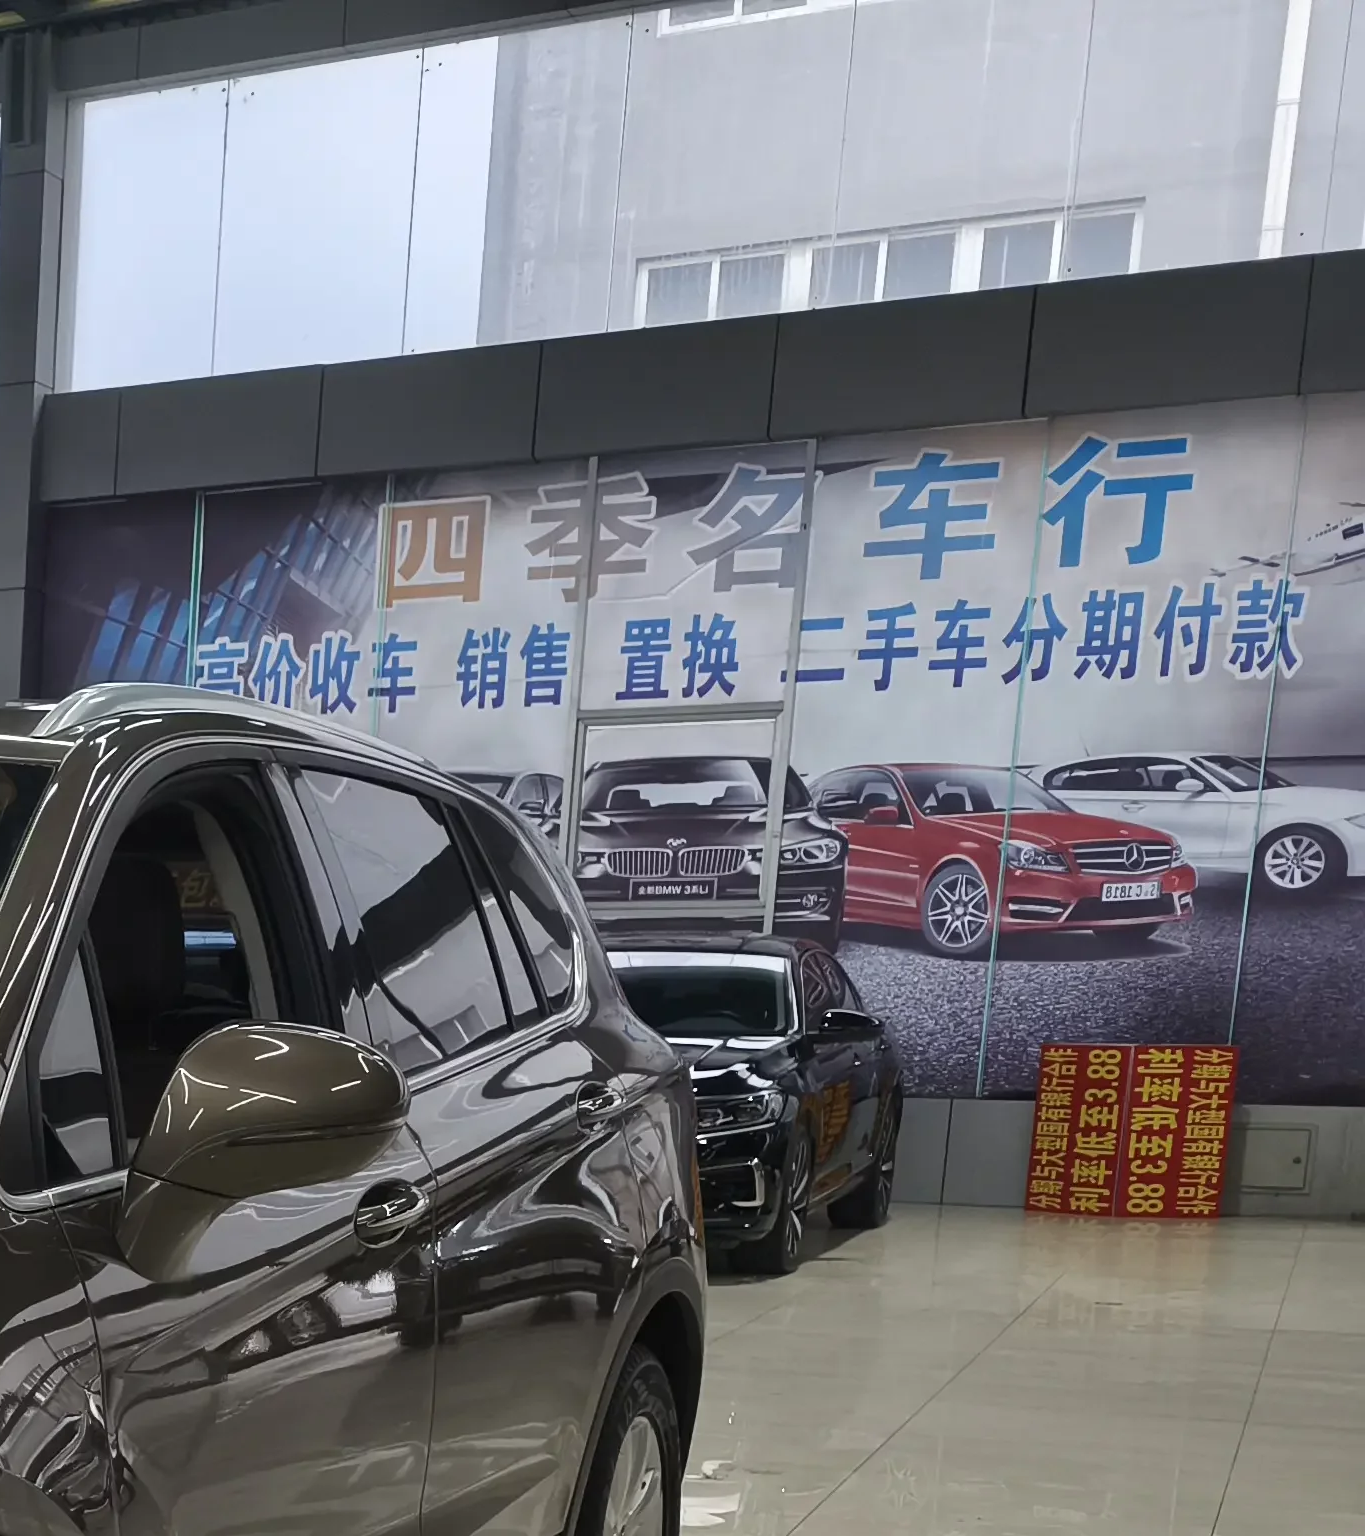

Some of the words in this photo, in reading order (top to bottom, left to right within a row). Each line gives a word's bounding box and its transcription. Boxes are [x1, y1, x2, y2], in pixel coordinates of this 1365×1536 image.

[381, 435, 1195, 608] 四季名车行
[198, 630, 418, 714] 高价收车
[456, 621, 571, 711] 销售
[615, 612, 740, 699] 置换
[780, 578, 1306, 691] 二手车分期付款
[1029, 1047, 1079, 1210] 分期与大型国有银行合作
[1069, 1048, 1122, 1214] 利率低至3.88
[1126, 1047, 1185, 1214] 利率低至3.88
[1175, 1048, 1234, 1216] 分期与大型国有银行合作
